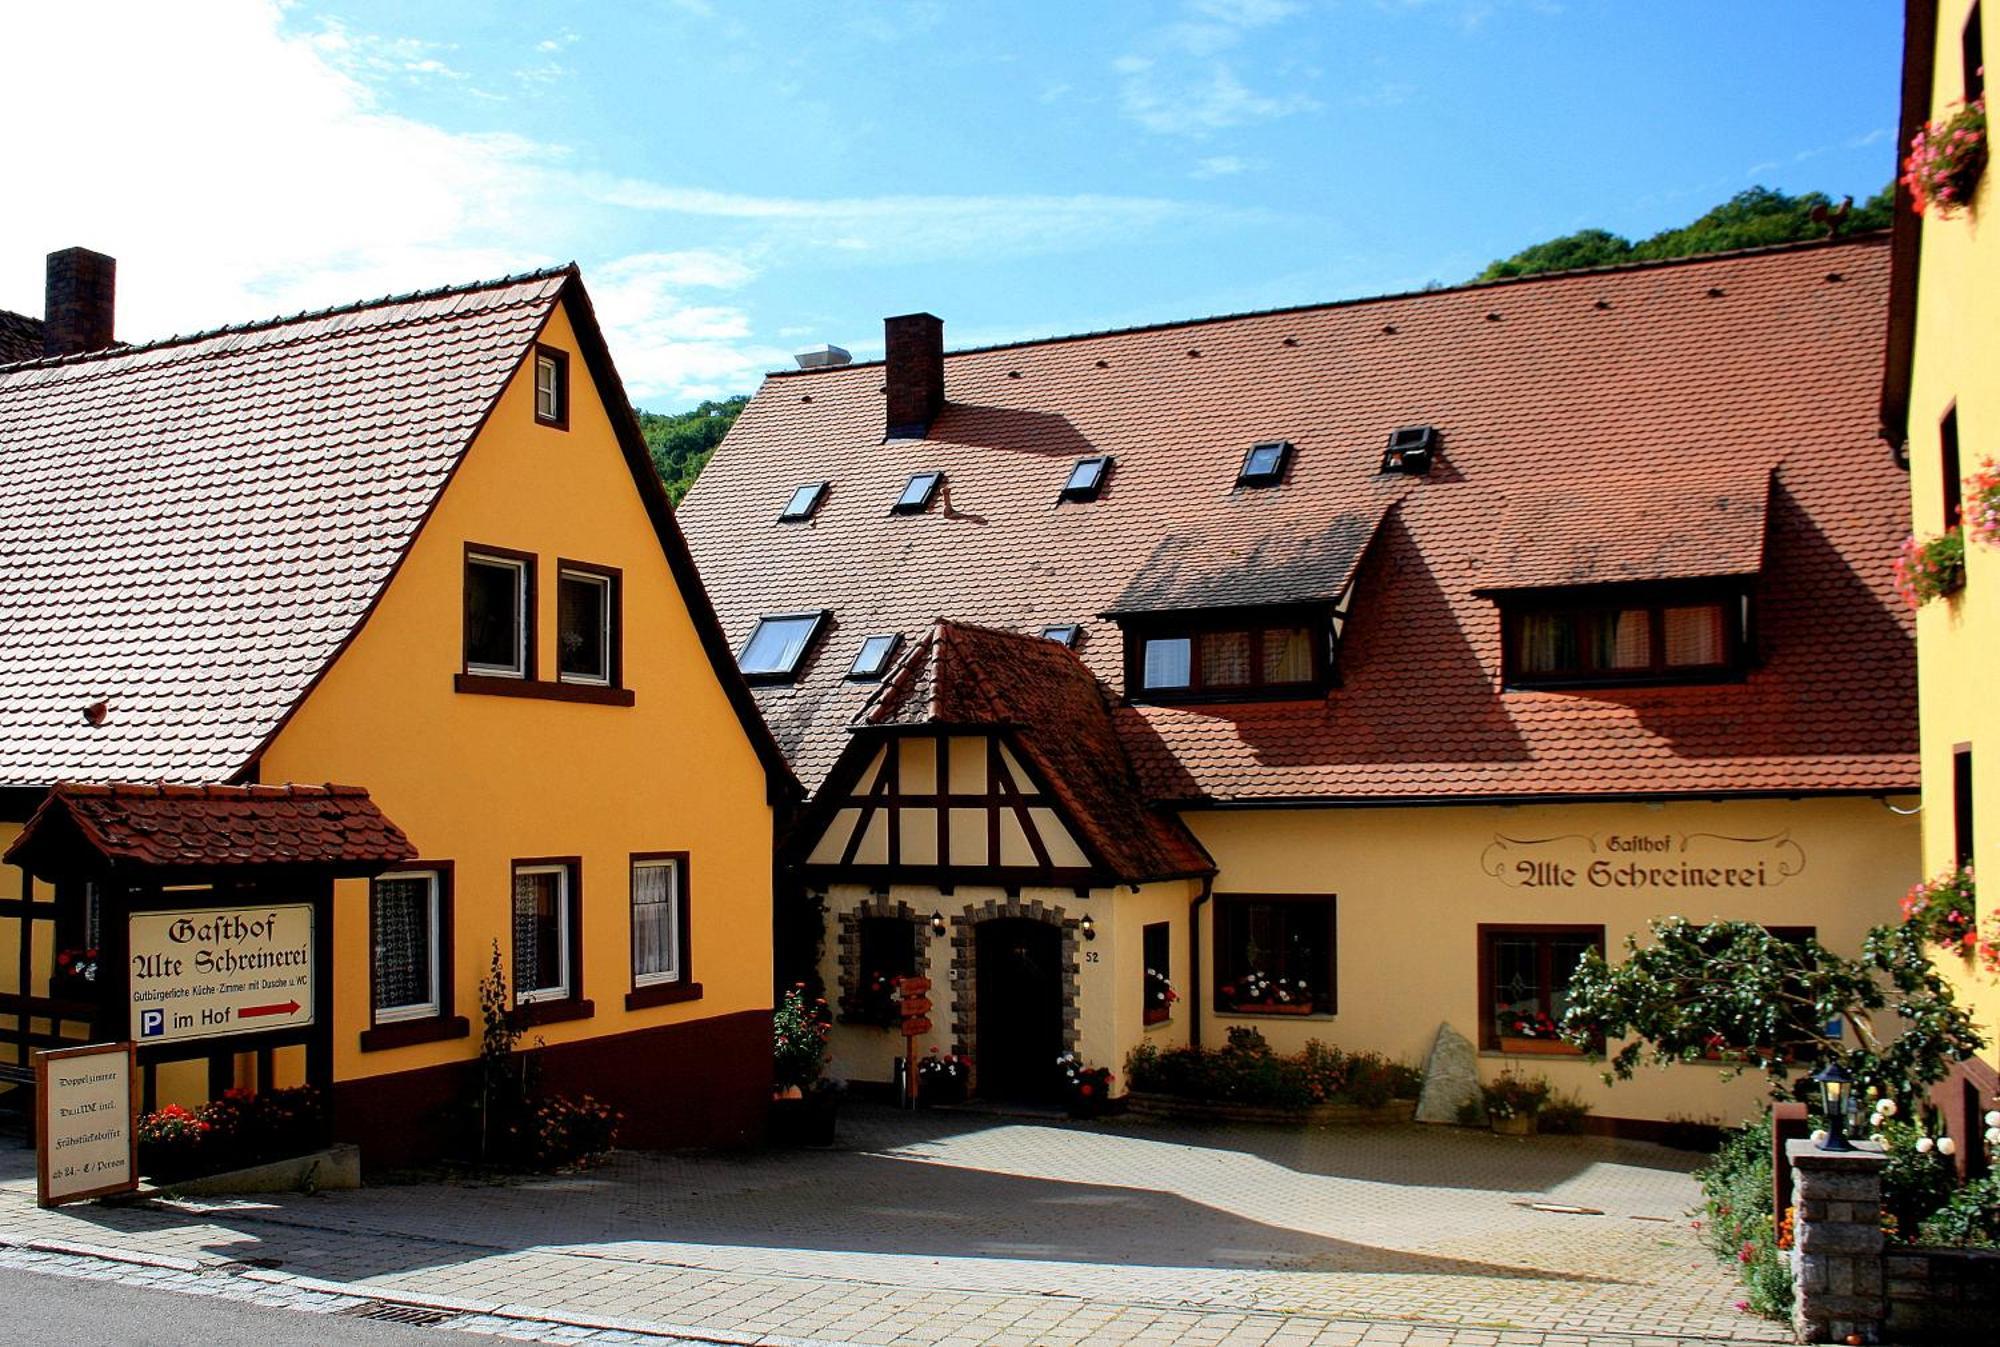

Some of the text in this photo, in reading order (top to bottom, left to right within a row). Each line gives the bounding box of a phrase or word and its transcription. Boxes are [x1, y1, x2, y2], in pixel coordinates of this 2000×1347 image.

[1515, 859, 1766, 889] Alte Schreinerei
[133, 944, 308, 980] Alte Schreinerei
[1085, 952, 1100, 963] 52
[133, 987, 190, 1002] Gutbürgerliche
[192, 984, 215, 997] Küche
[248, 979, 260, 990] mit
[262, 977, 288, 989] Dusche
[296, 975, 308, 985] WC
[143, 1007, 231, 1035] P im Hof
[59, 1072, 118, 1088] Doppelzimmer
[52, 1169, 63, 1180] ab
[98, 1159, 125, 1172] Person
